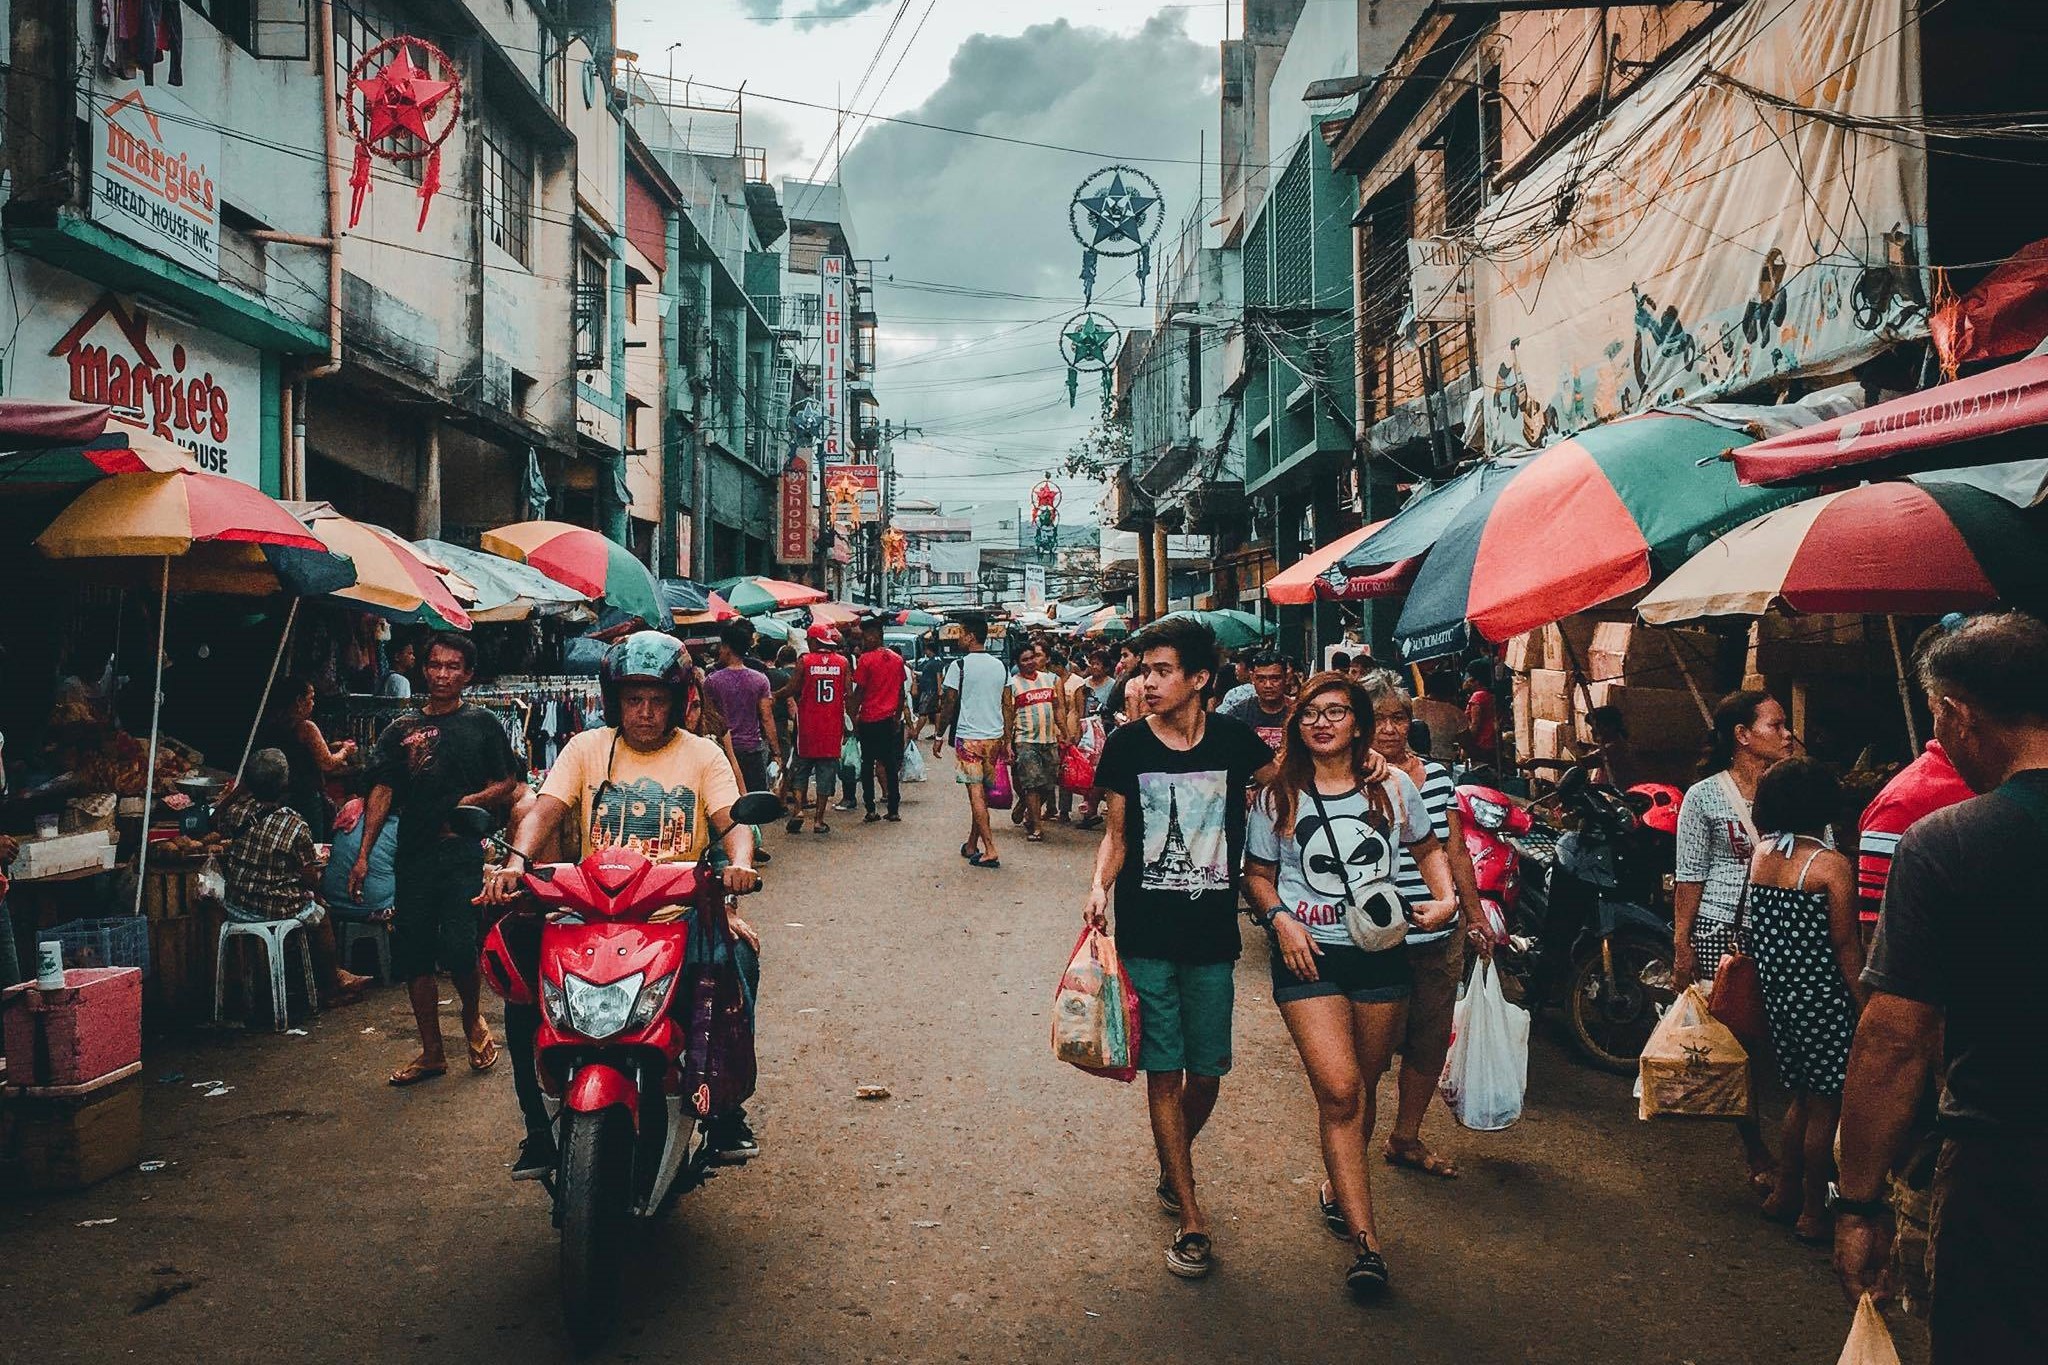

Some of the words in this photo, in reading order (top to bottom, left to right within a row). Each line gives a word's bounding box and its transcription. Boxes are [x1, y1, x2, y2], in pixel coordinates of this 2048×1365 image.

[107, 122, 214, 212] margie's
[105, 177, 147, 219] BREAD
[150, 202, 189, 241] HOUSE
[192, 223, 213, 254] INC.
[826, 259, 840, 273] M
[67, 341, 229, 443] margie's
[177, 437, 228, 474] OUSE
[817, 679, 834, 703] 15
